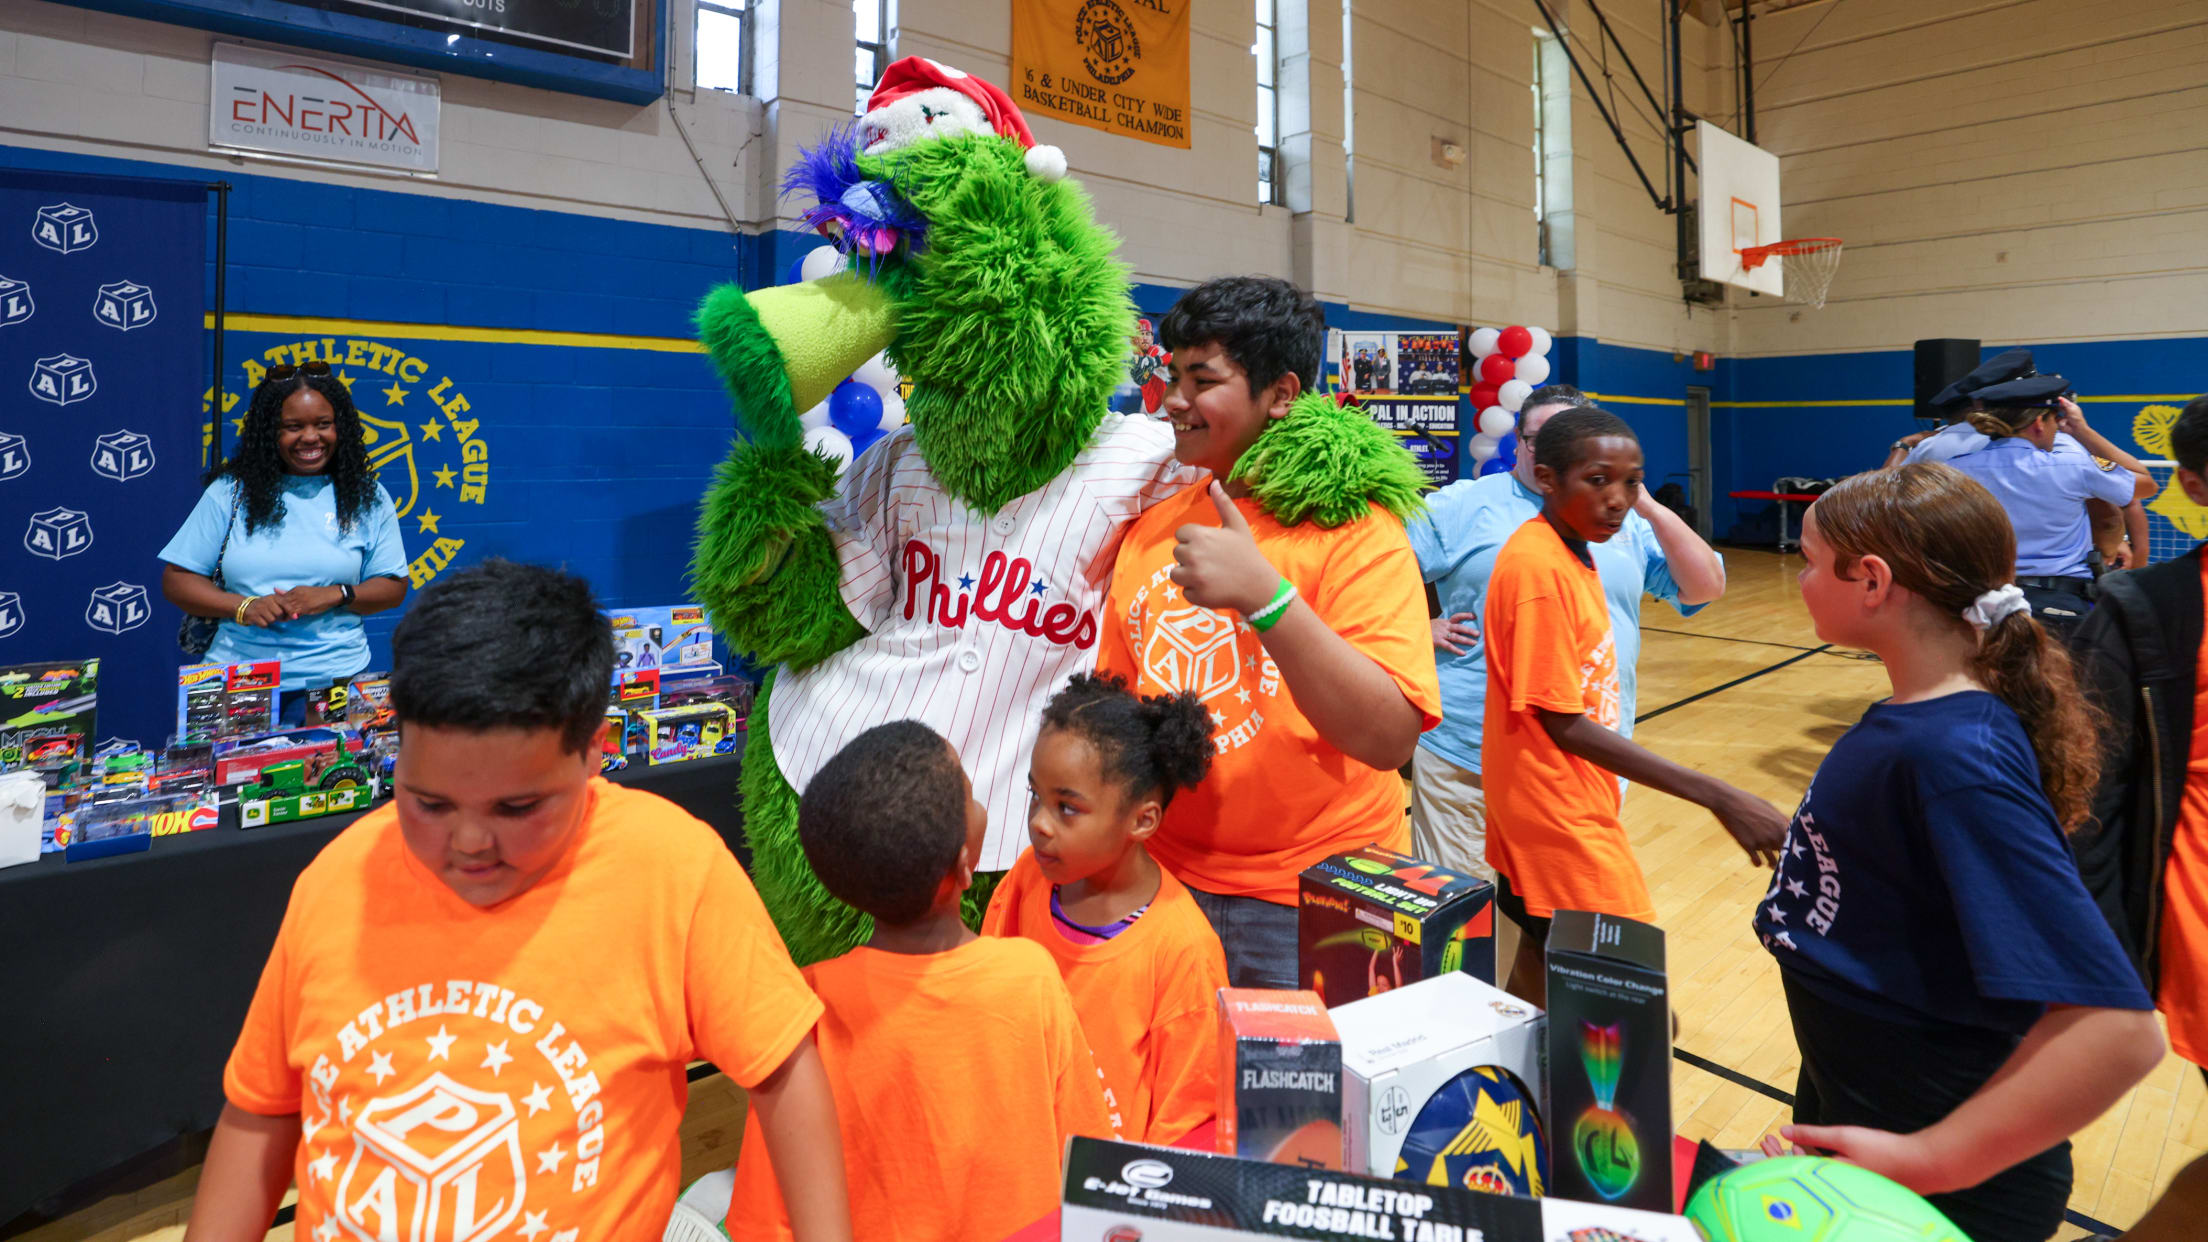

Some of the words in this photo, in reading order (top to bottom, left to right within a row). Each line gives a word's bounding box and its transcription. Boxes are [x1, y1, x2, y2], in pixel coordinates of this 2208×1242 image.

[1023, 84, 1111, 123] BASKETBALL
[1116, 112, 1184, 139] CHAMPION
[1041, 73, 1052, 88] &
[1061, 77, 1107, 104] UNDER
[1113, 93, 1146, 113] CITY
[1152, 102, 1182, 122] WIDE
[233, 86, 420, 145] ENERTIA
[231, 123, 345, 145] CONTINUOUSLY
[350, 139, 364, 148] IN
[368, 141, 423, 156] MOTION
[242, 338, 429, 388] ATHLETIC
[427, 376, 489, 504] LEAGUE
[1369, 404, 1393, 421] PAL
[1396, 404, 1408, 421] IN
[1411, 404, 1455, 421] ACTION
[903, 539, 1097, 651] Phillies
[650, 742, 688, 760] Candy
[1800, 812, 1842, 937] LEAGUE
[1331, 877, 1399, 905] FOOTBALL
[1396, 900, 1430, 914] SET
[1374, 883, 1418, 903] LIGHT
[1413, 895, 1438, 907] UP
[1400, 920, 1414, 934] $10
[1549, 963, 1595, 981] Vibration
[1596, 974, 1623, 986] Color
[1625, 980, 1664, 996] Change
[1235, 1001, 1319, 1016] FLASHCATCH
[337, 980, 544, 1063] ATHLETIC
[536, 1021, 605, 1193] LEAGUE
[1242, 1069, 1335, 1094] FLASHCATCH
[1381, 1107, 1392, 1123] 13
[1396, 1105, 1408, 1116] 5
[1144, 1188, 1213, 1209] Games
[1307, 1180, 1433, 1219] TABLETOP
[1262, 1199, 1395, 1240] FOOSBALL
[1401, 1217, 1484, 1242] TABLE
